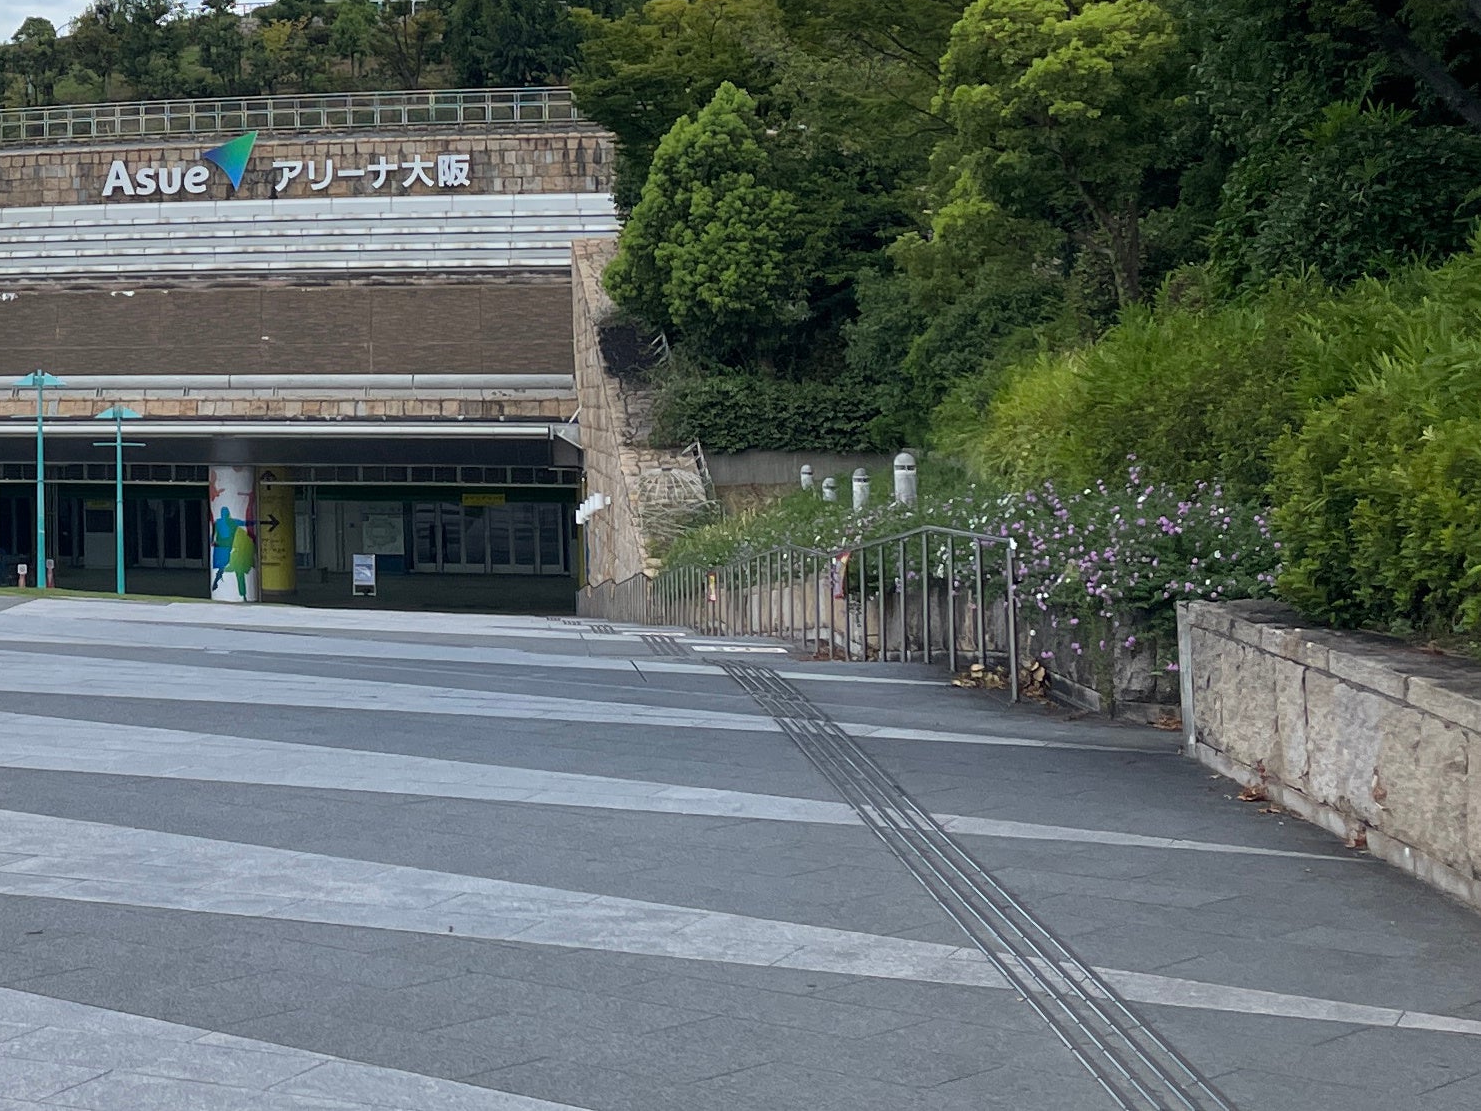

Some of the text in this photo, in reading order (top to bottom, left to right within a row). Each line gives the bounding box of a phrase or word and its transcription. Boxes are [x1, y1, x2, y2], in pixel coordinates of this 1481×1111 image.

[102, 154, 471, 196] Asue アリーナ大阪
